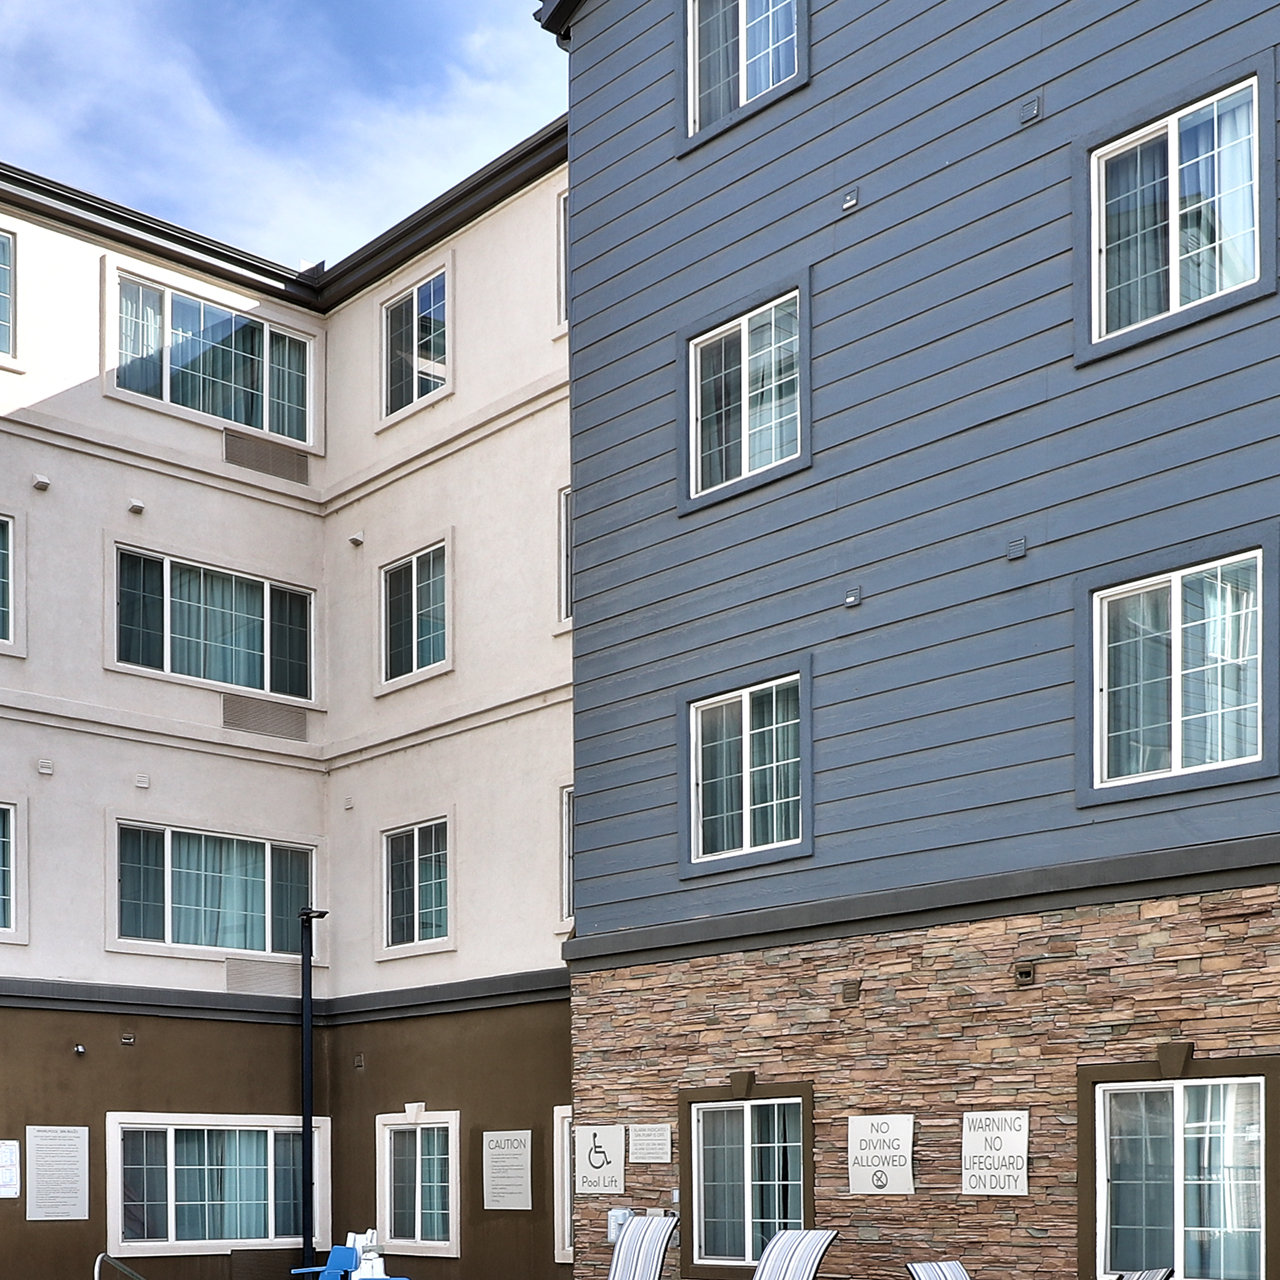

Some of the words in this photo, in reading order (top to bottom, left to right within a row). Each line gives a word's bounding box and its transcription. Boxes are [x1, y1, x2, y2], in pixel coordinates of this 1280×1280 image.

[870, 1121, 890, 1134] NO
[967, 1116, 1022, 1132] WARNING
[488, 1138, 527, 1150] CAUTION
[859, 1138, 901, 1151] DIVING
[984, 1136, 1003, 1151] NO
[852, 1154, 907, 1168] ALLOWED
[963, 1155, 1025, 1171] LIFEGUARD
[581, 1175, 600, 1188] Pool
[602, 1175, 618, 1188] Lift
[968, 1174, 986, 1190] ON
[989, 1174, 1020, 1190] DUTY
